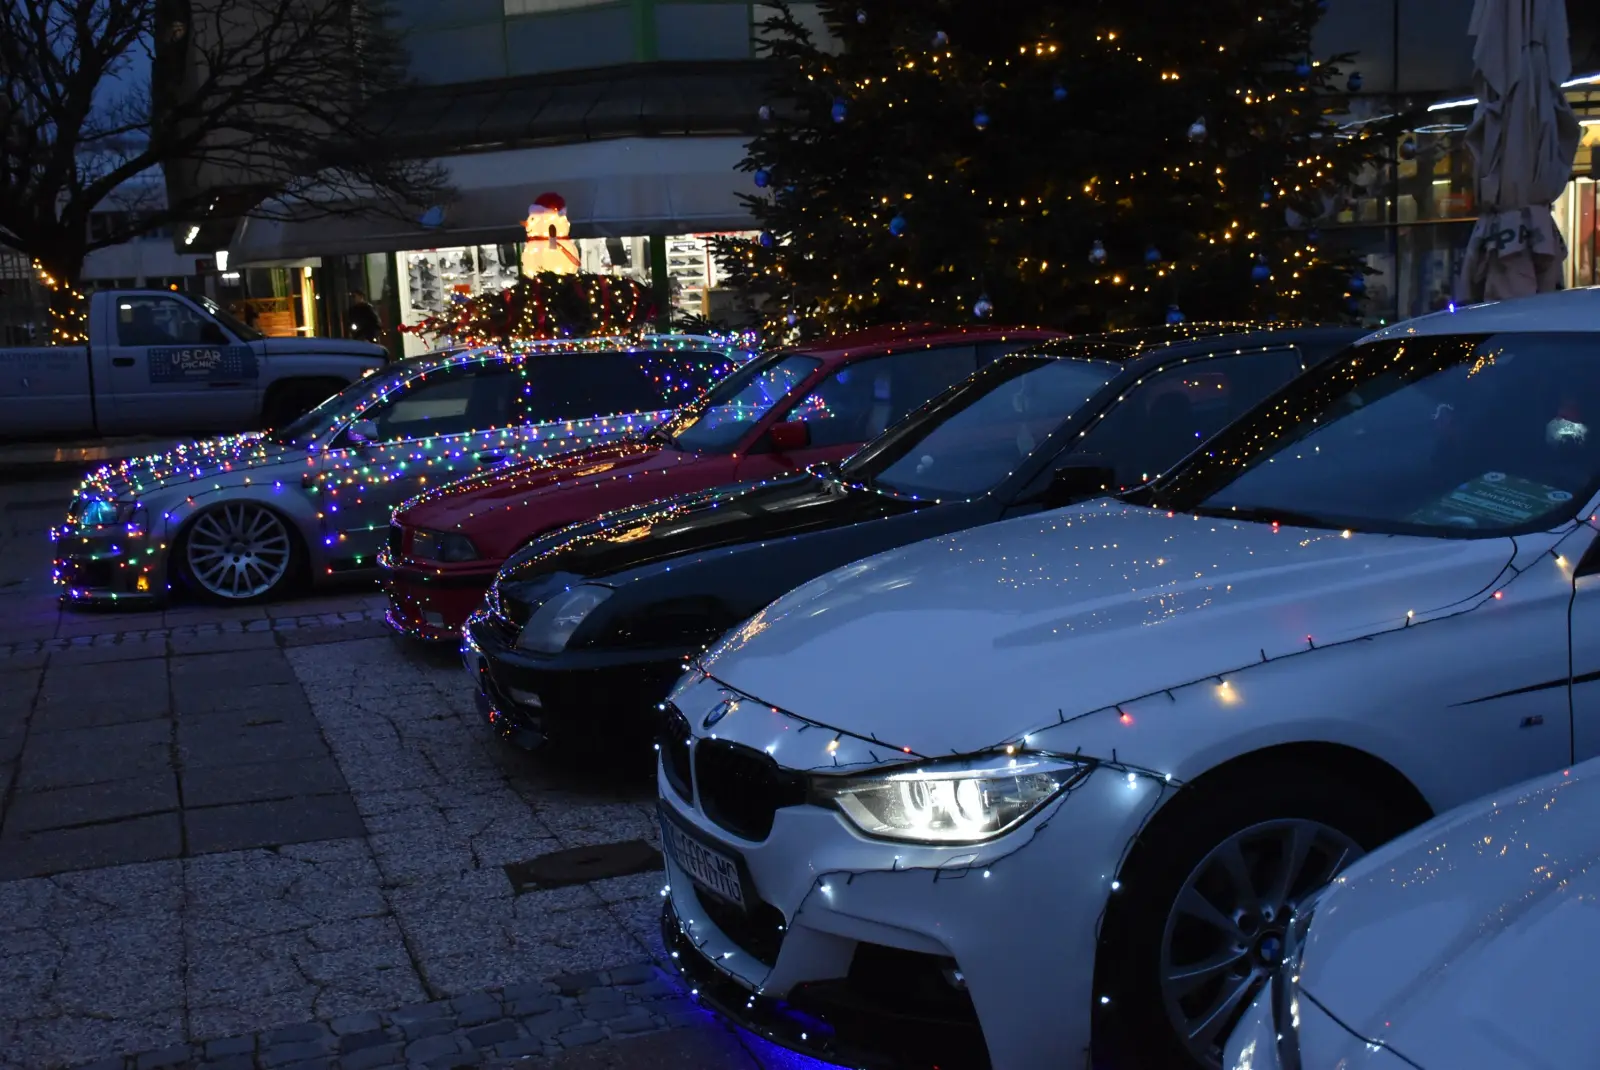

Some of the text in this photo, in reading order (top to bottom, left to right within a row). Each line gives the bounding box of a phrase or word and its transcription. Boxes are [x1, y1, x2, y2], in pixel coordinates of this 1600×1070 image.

[171, 349, 222, 365] US CAR
[181, 360, 217, 370] PICNIC
